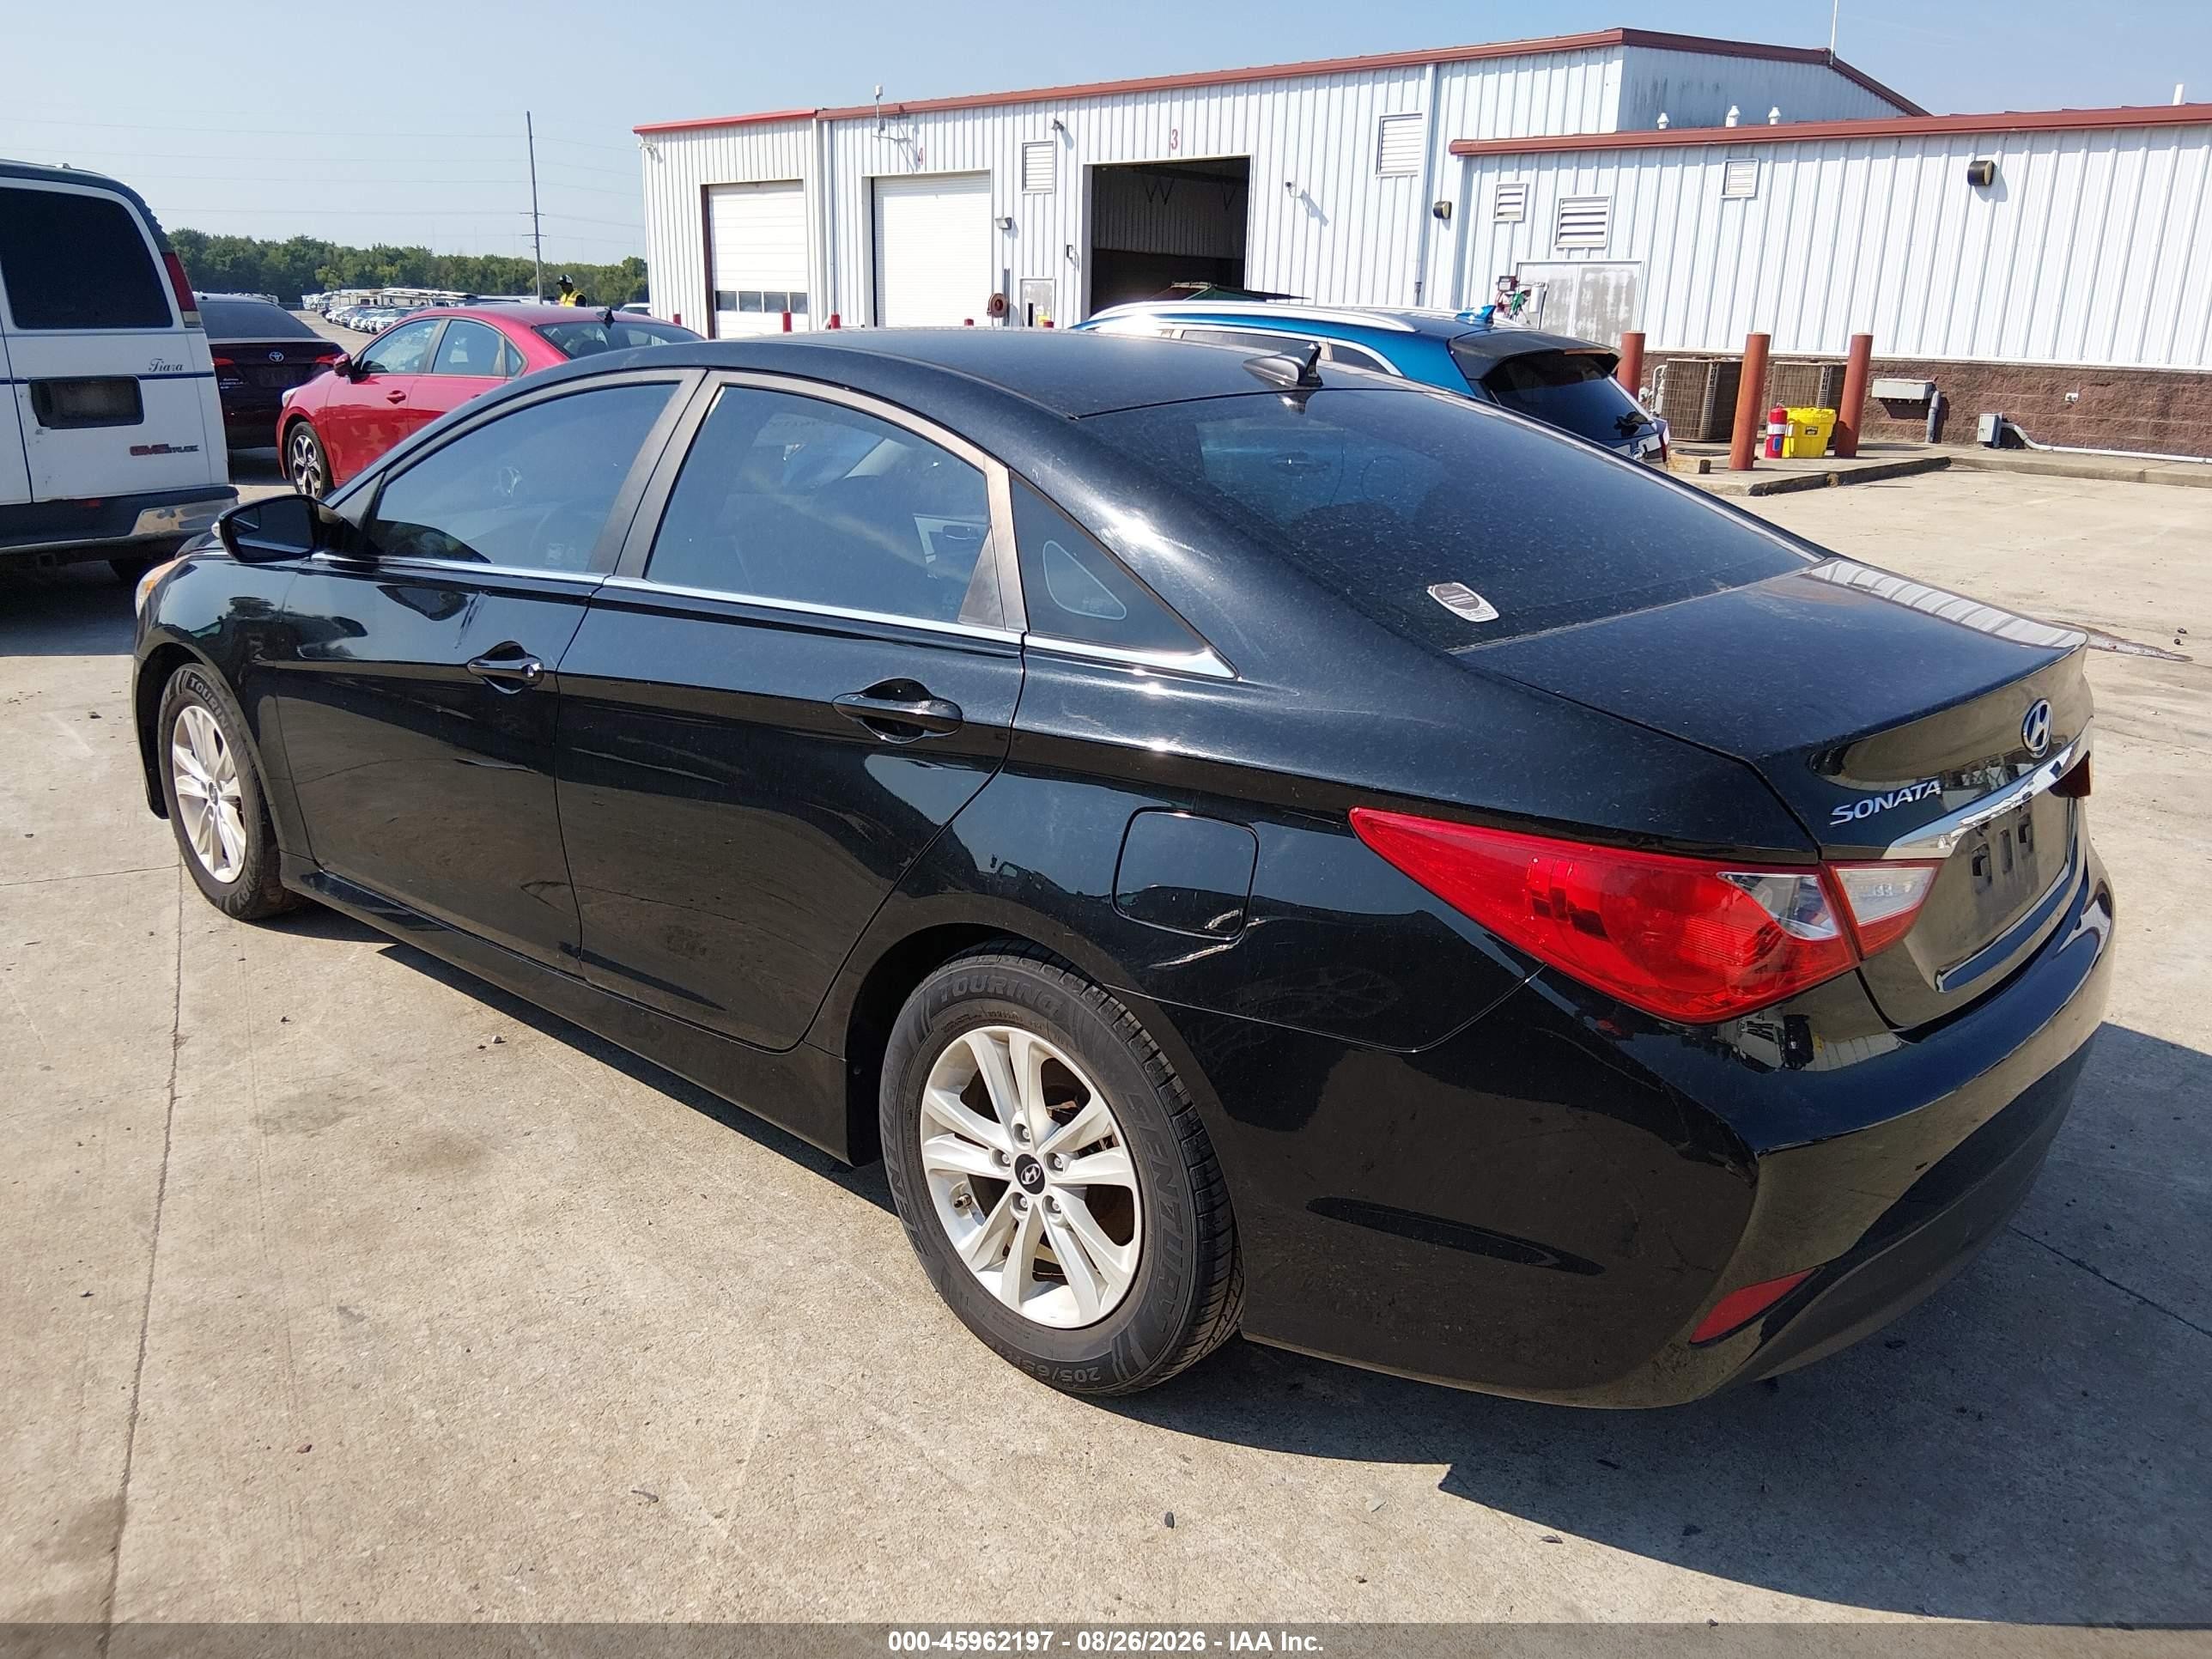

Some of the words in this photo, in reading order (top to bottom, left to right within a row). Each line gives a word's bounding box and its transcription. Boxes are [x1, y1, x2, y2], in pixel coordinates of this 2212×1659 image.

[1171, 128, 1178, 150] 3
[918, 147, 924, 166] 4
[1829, 779, 1942, 826] SONATA
[939, 974, 1065, 1018] TOURING
